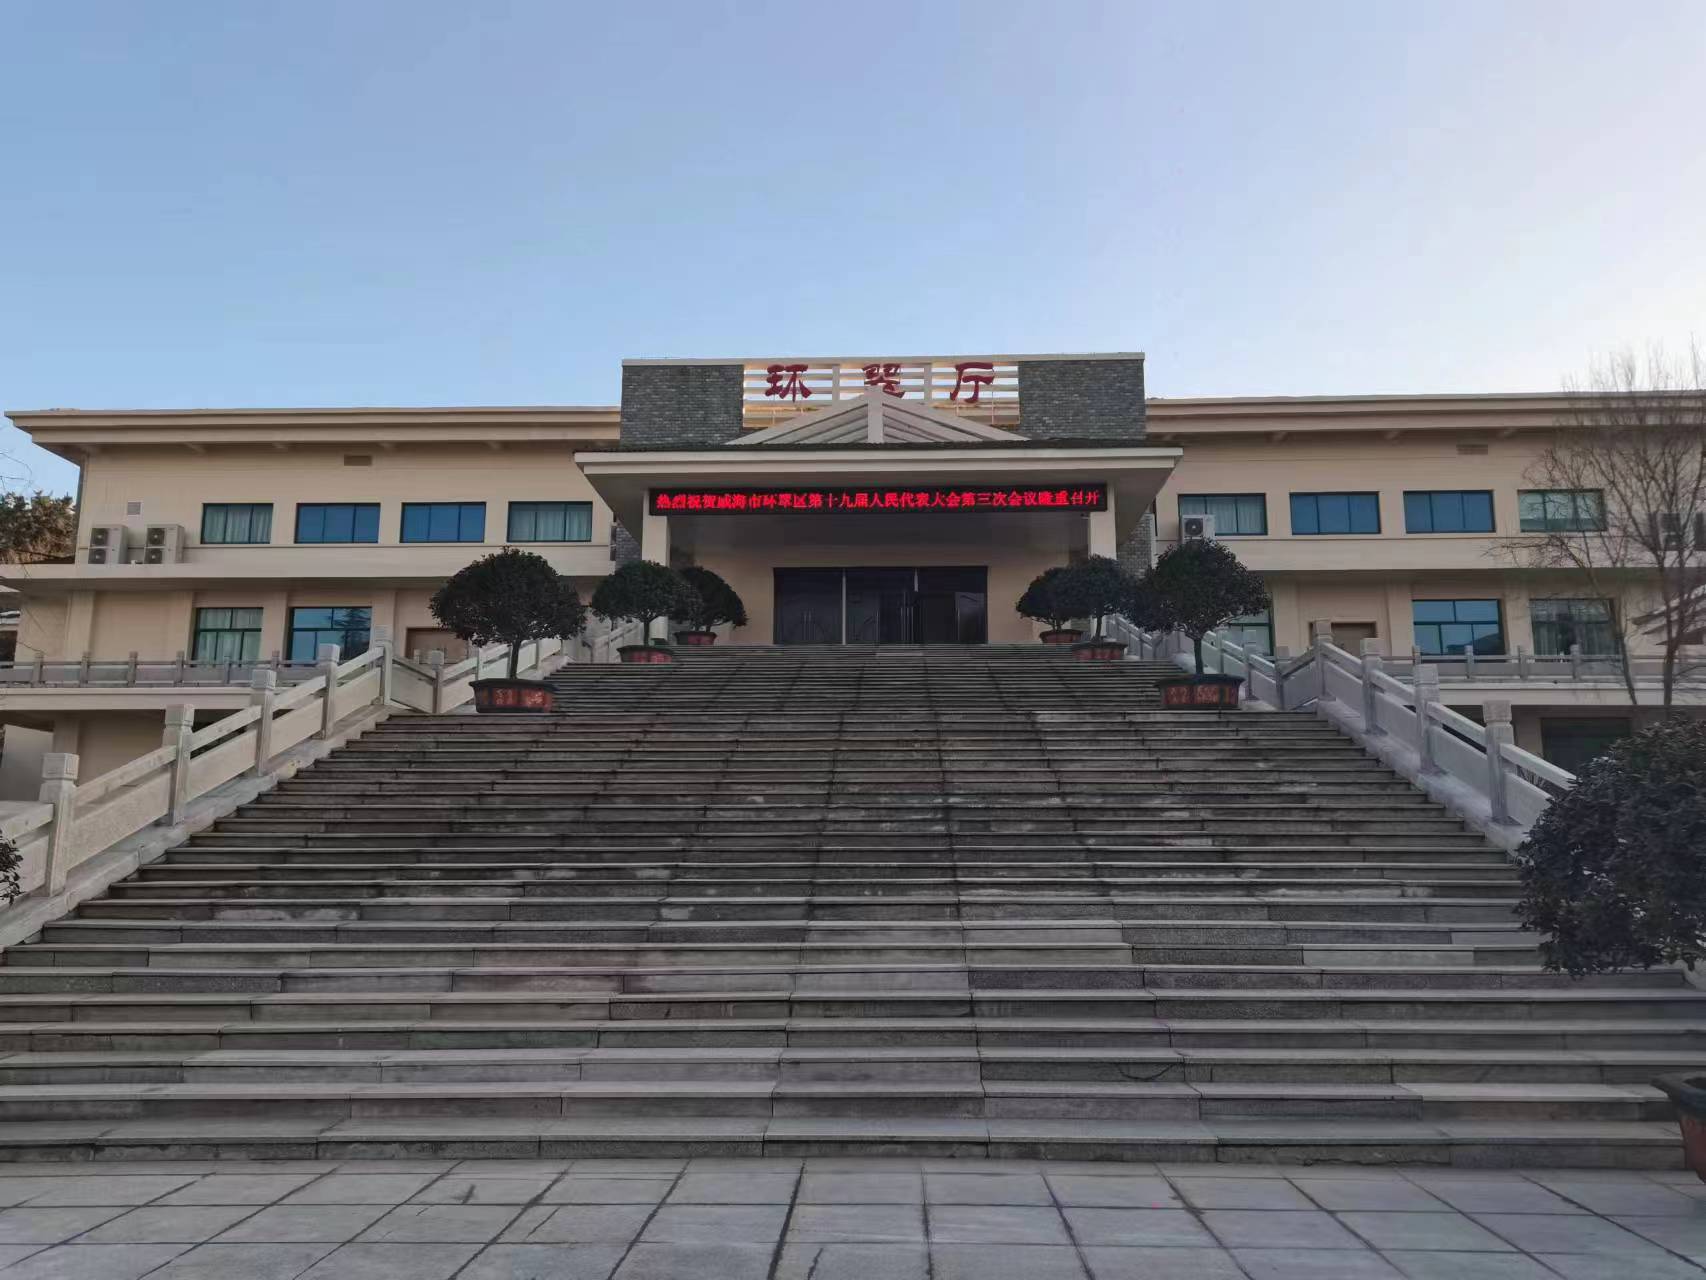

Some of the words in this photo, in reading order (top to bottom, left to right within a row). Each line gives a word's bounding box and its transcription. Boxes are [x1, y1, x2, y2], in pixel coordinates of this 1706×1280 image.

[656, 490, 1100, 510] 热烈祝贺威海市环翠区第十九届人民代表大会第三次会议隆重召开
